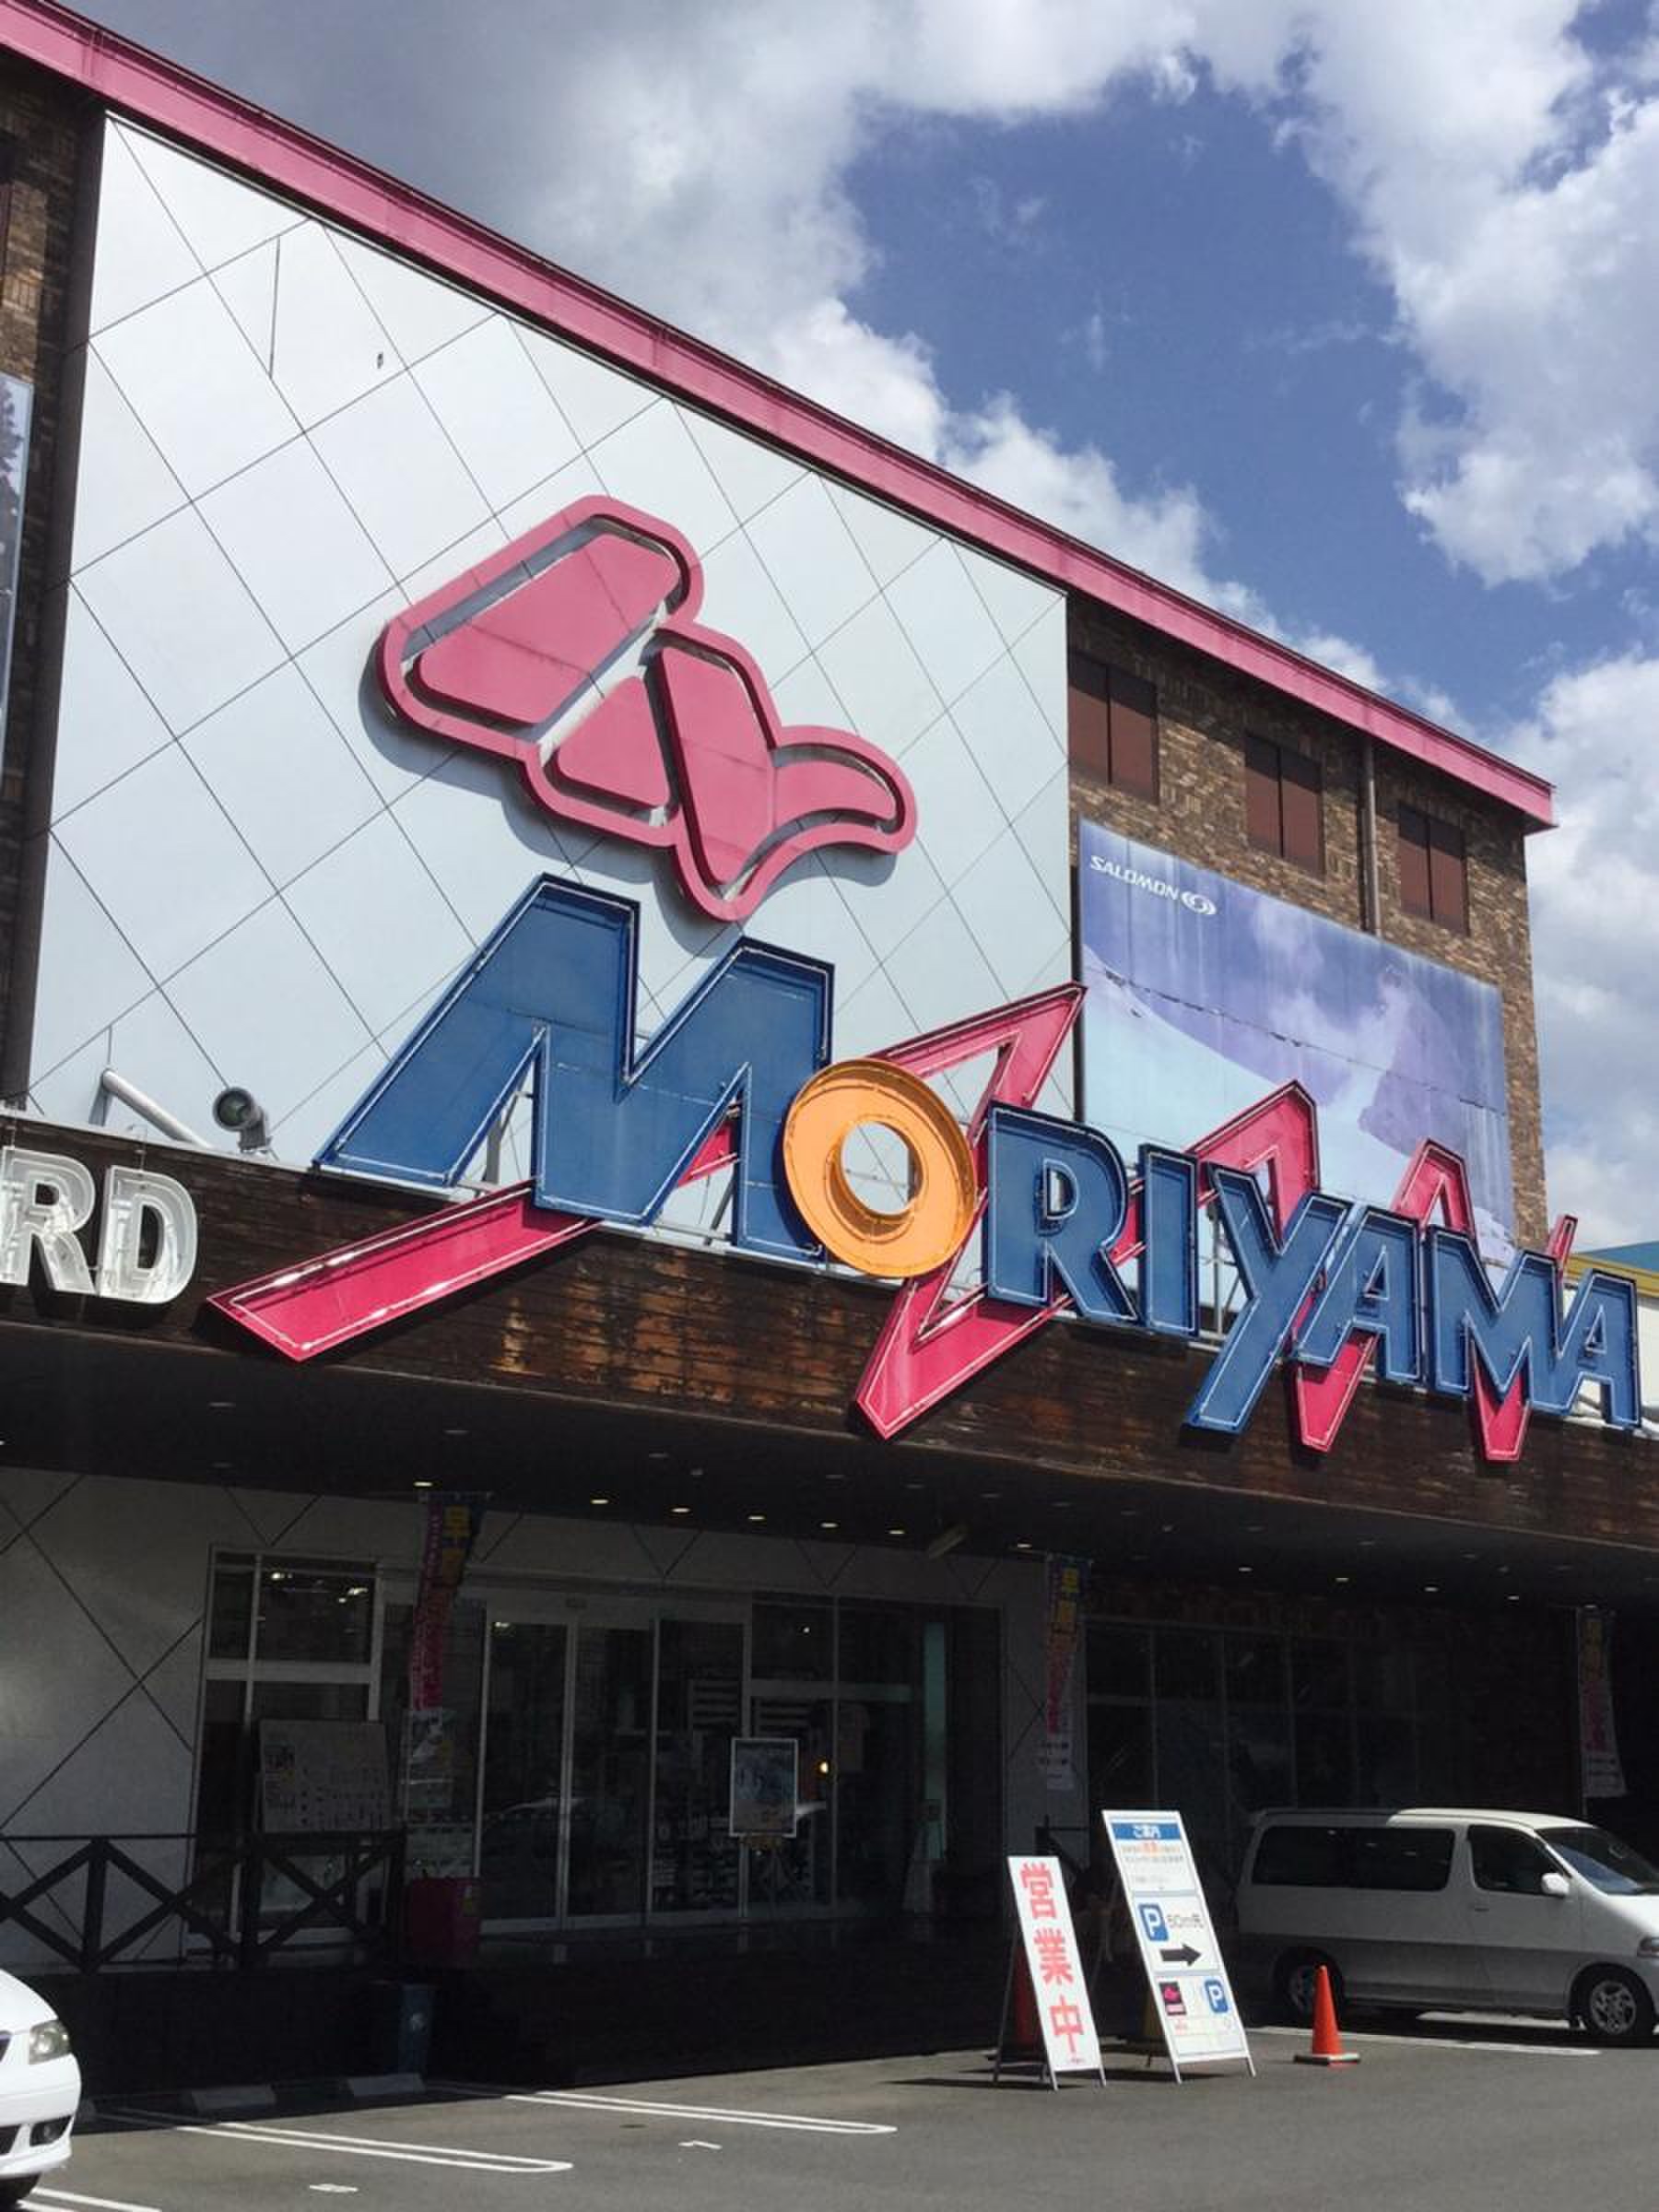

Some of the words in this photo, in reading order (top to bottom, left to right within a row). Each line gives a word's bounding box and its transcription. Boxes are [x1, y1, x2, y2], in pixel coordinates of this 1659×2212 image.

[1089, 853, 1180, 901] SALOMON
[0, 1146, 198, 1304] RD
[312, 872, 1642, 1434] MORIYAMA
[1019, 1862, 1085, 2053] 営業中
